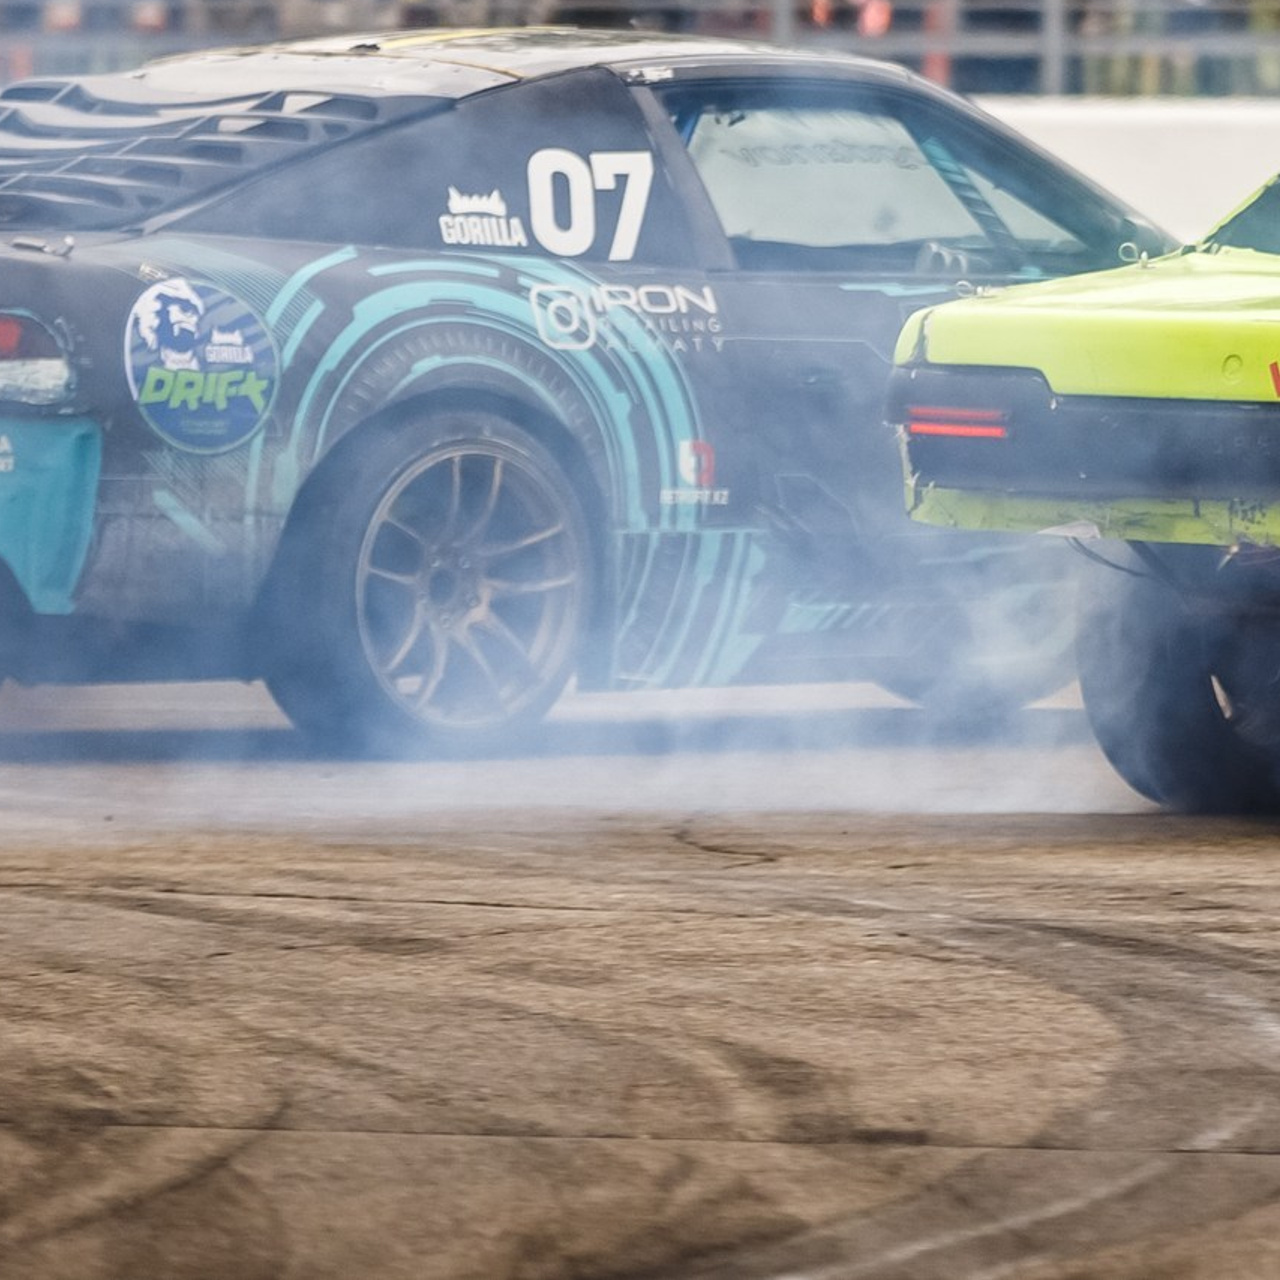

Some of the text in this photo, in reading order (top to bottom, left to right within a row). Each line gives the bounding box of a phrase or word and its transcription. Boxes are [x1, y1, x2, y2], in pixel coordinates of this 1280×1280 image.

[527, 147, 655, 261] 07
[439, 214, 528, 247] GORILLA
[589, 284, 718, 314] IRON
[138, 366, 269, 416] DRIFT
